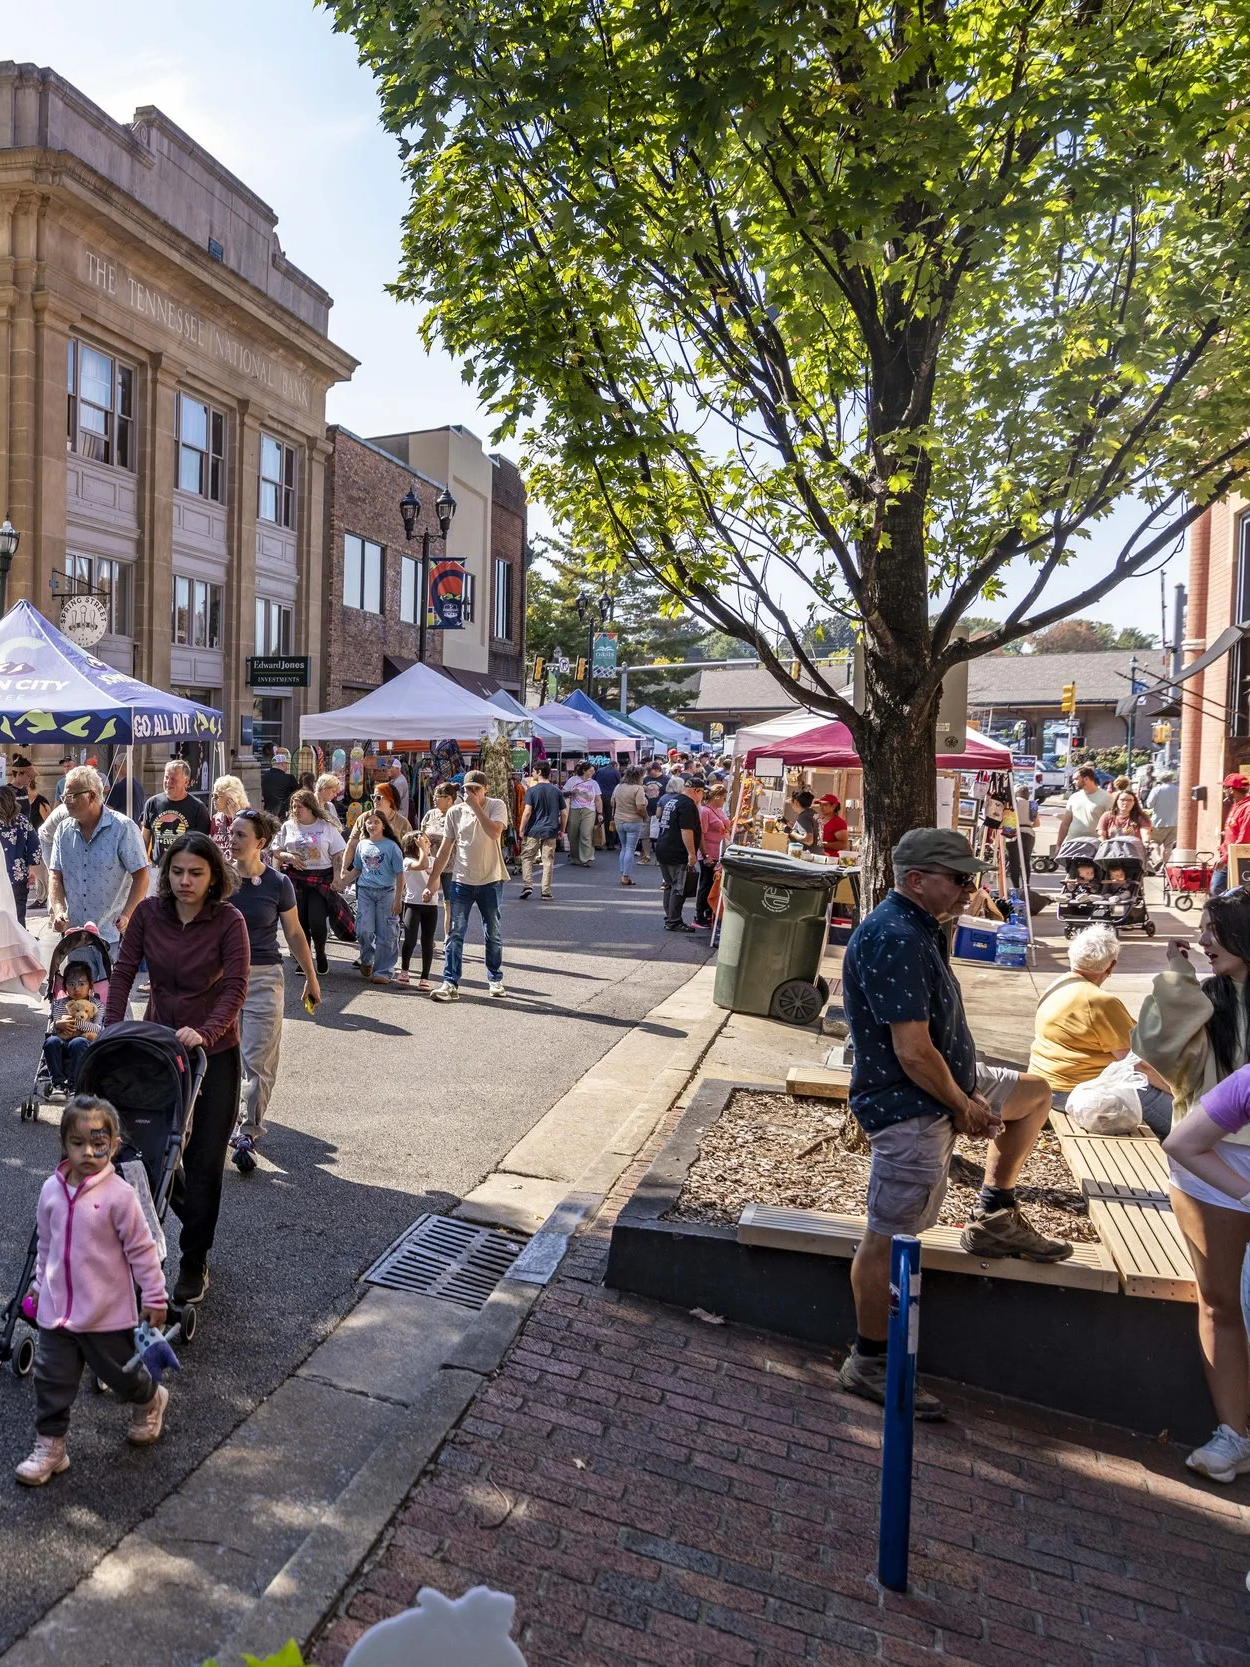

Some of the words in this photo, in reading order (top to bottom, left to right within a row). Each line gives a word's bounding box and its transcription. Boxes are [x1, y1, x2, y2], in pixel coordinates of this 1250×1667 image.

[85, 251, 116, 296] THE
[128, 277, 205, 347] TENNESSEE
[214, 328, 274, 388] NATIONAL
[281, 371, 309, 408] BANK
[60, 597, 82, 624] SPRING
[85, 597, 107, 623] STREET
[15, 679, 71, 691] CITY
